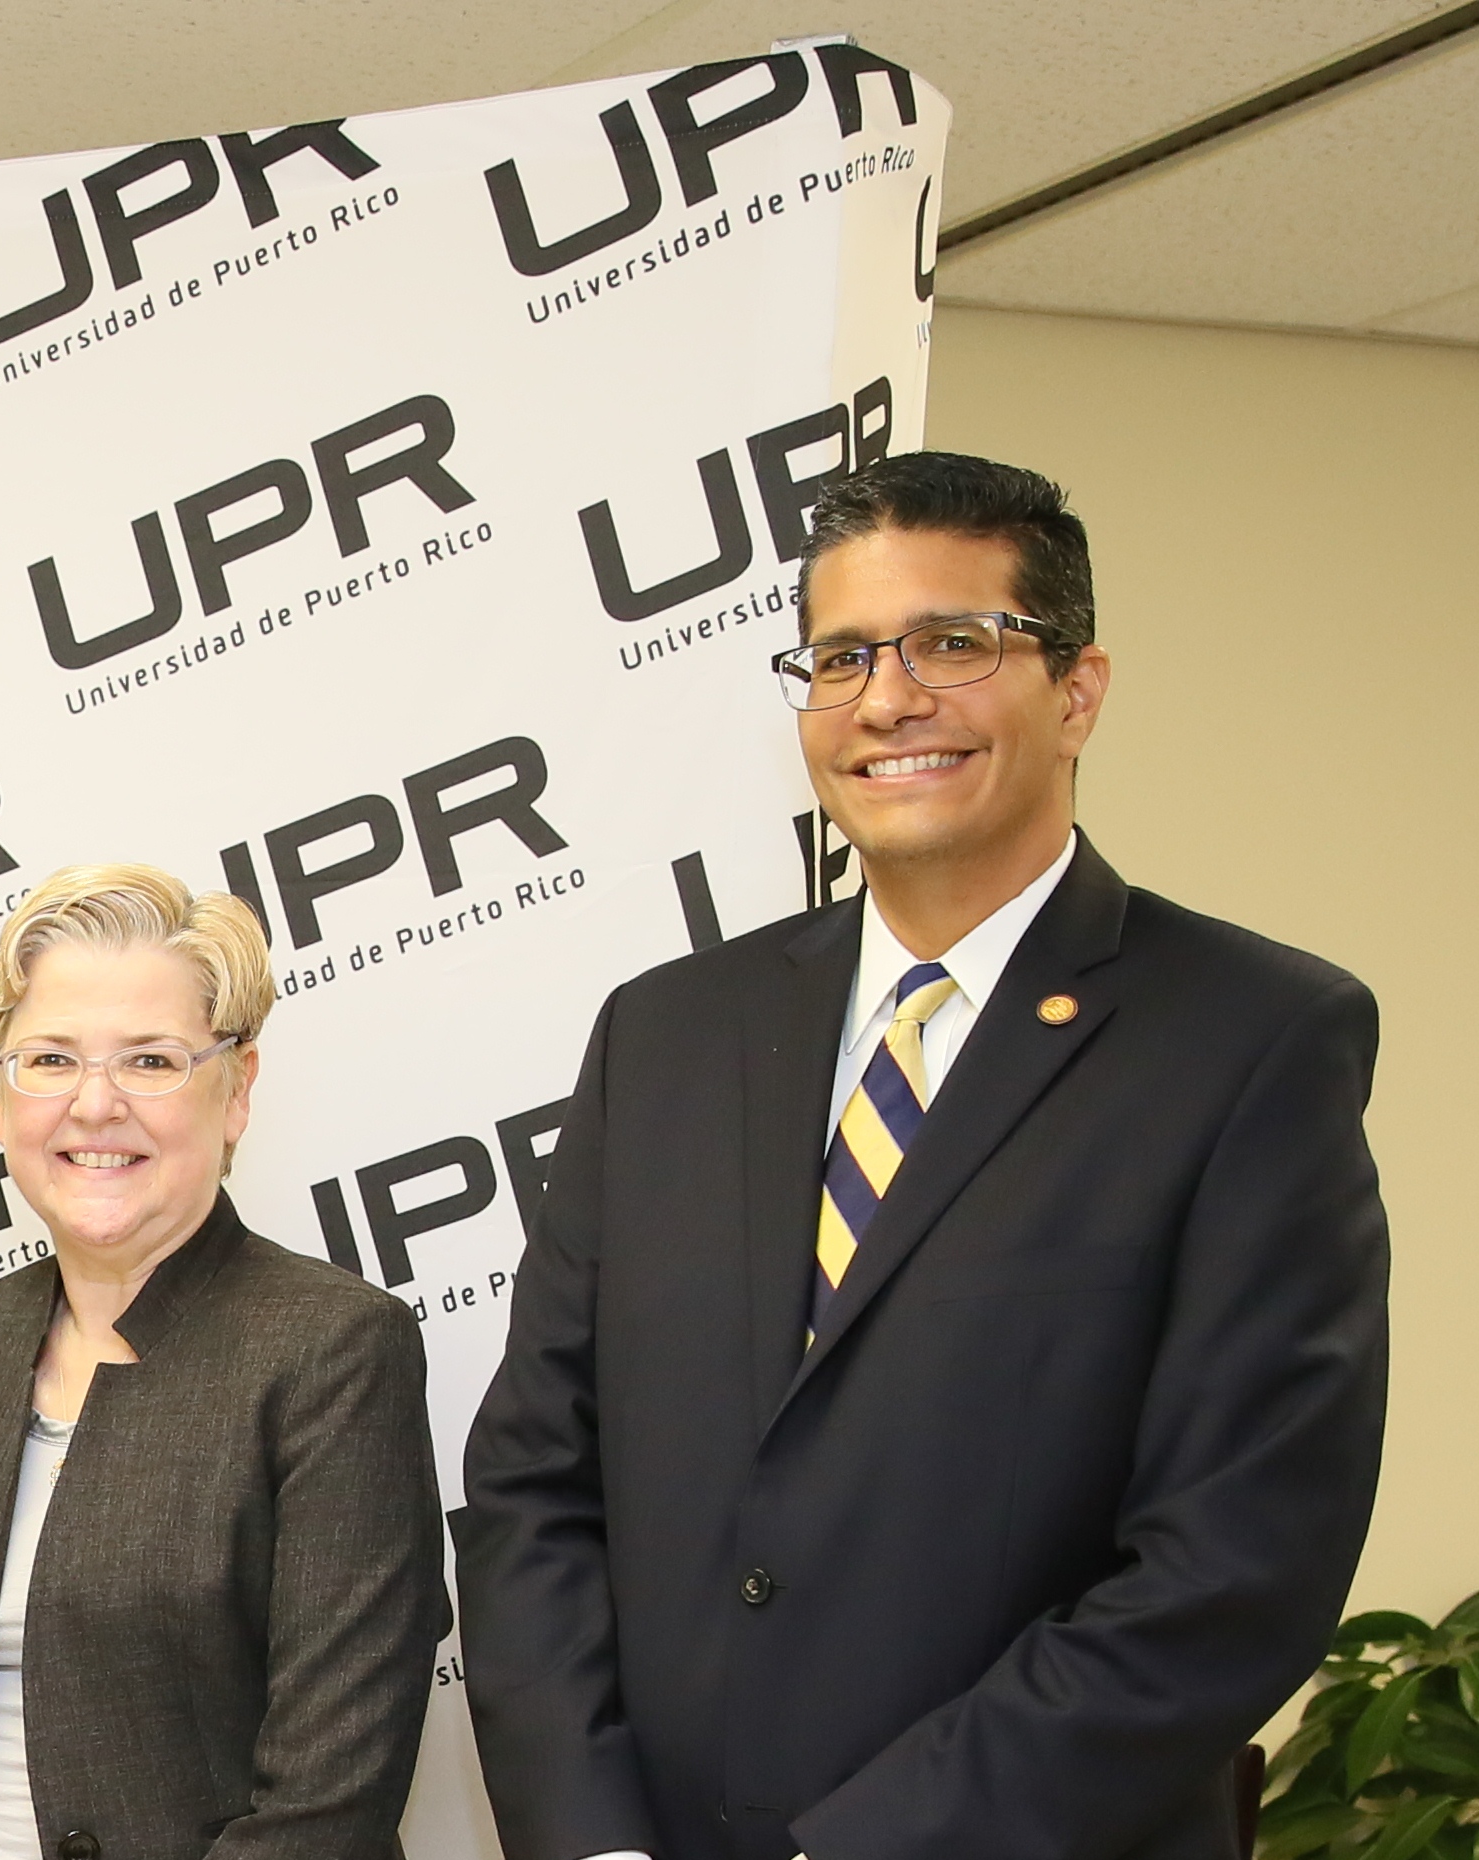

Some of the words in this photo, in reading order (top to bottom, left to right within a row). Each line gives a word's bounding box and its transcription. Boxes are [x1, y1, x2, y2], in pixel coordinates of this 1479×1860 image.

[168, 278, 202, 306] de
[214, 225, 318, 285] Puerto
[330, 185, 400, 230] Rico
[527, 210, 732, 323] Universidad
[747, 192, 784, 224] de
[800, 152, 875, 203] Puerto
[881, 146, 915, 174] Rico
[26, 393, 477, 671] UPR
[65, 620, 246, 715] Universidad
[258, 602, 292, 636] de
[304, 557, 410, 617] Puerto
[422, 521, 493, 566] Rico
[619, 583, 800, 670] Universida
[349, 941, 384, 973] de
[396, 900, 503, 955] Puerto
[515, 867, 585, 910] Rico
[442, 1286, 476, 1313] de
